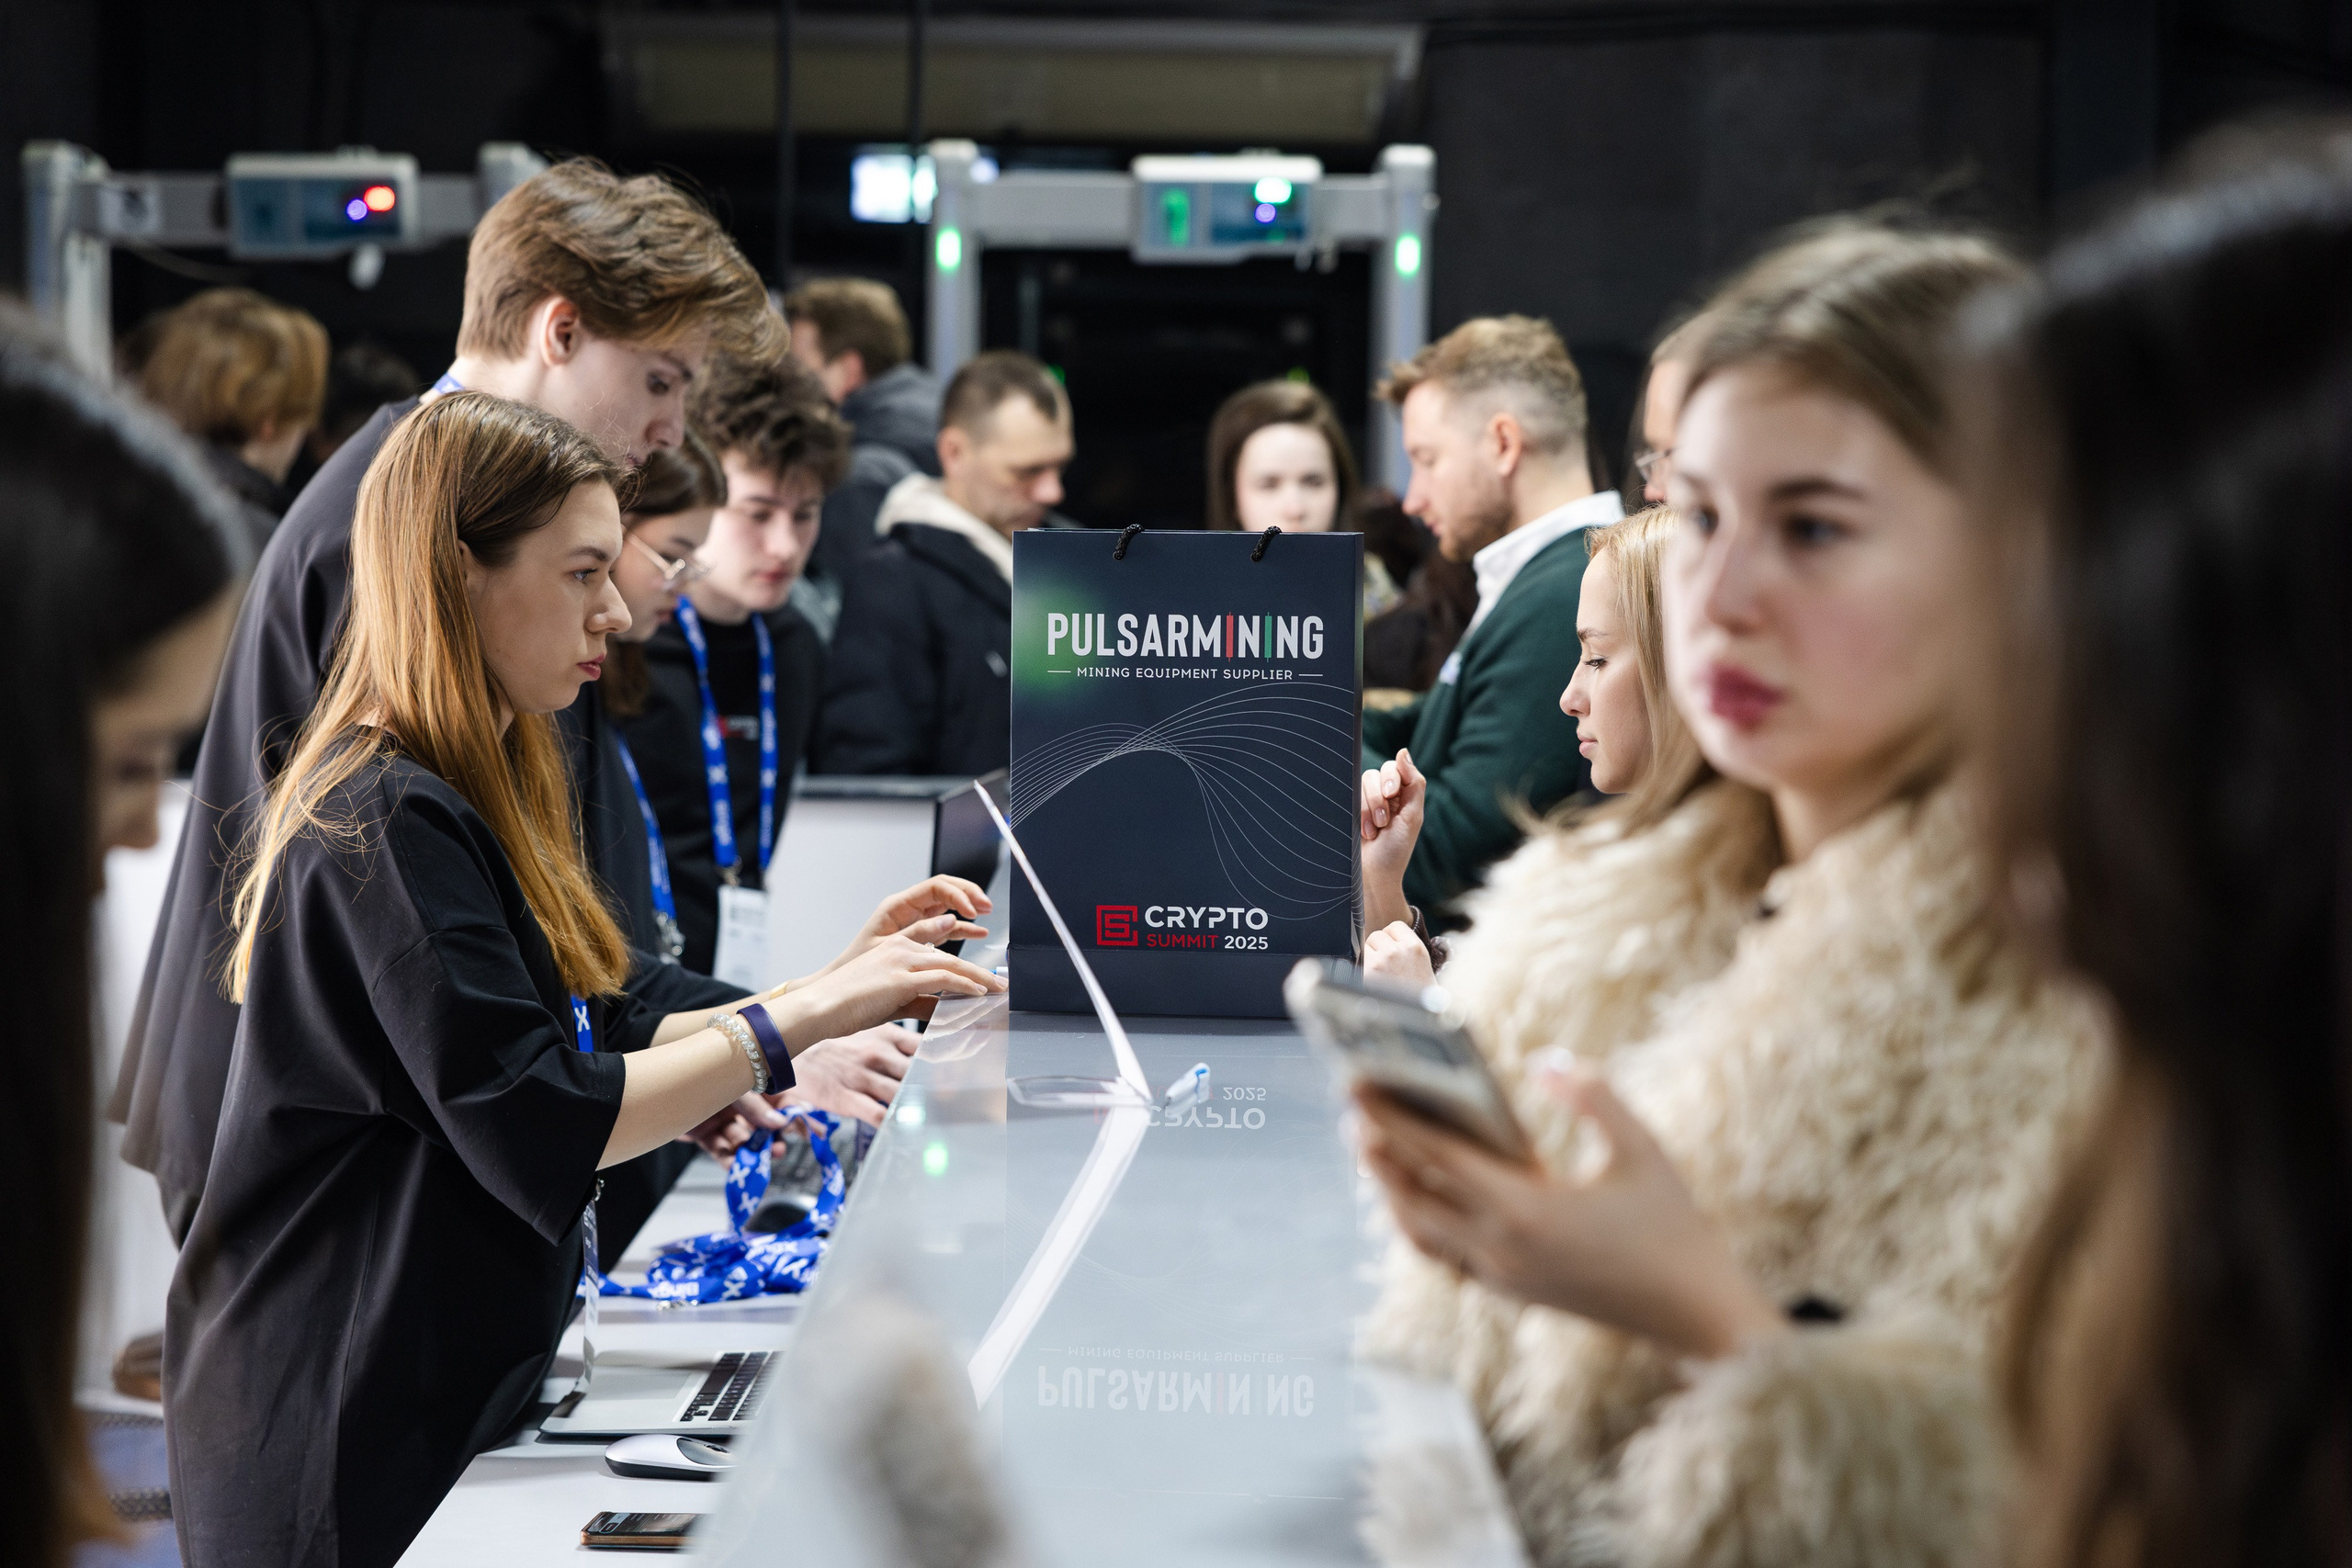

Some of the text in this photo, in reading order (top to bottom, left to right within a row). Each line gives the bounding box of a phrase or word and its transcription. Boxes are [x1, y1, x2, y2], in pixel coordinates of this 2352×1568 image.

[1047, 612, 1323, 662] PULSARMINING
[1077, 666, 1293, 681] MINING EQUIPMENT SUPPLIER
[1145, 906, 1268, 931] CRYPTO
[1147, 933, 1269, 950] SUMMIT 2025
